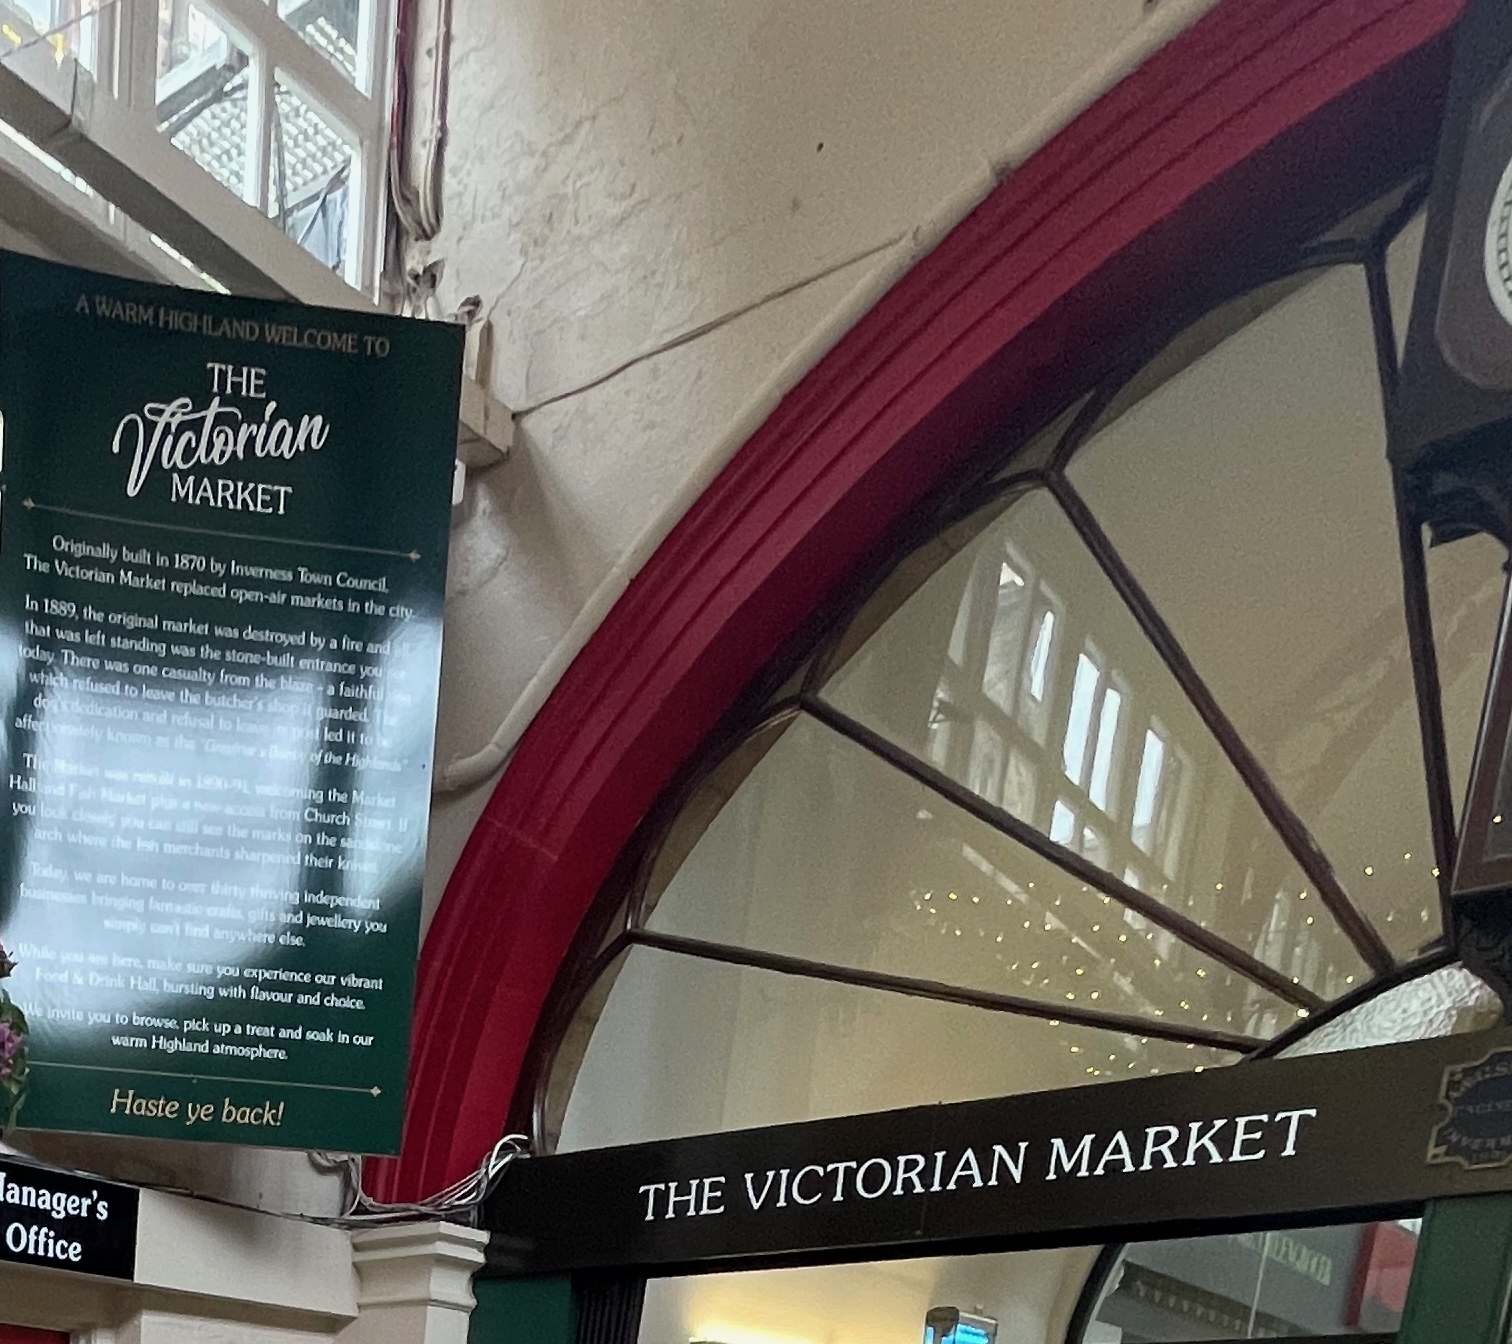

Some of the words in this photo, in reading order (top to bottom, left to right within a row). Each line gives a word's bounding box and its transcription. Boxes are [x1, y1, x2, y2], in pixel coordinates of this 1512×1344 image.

[75, 293, 89, 314] A
[94, 294, 154, 325] WARM
[158, 306, 259, 341] HIGHLAND
[264, 322, 357, 353] WELCOME
[362, 335, 389, 357] TO
[206, 362, 266, 398] THE
[112, 396, 330, 498] Victorian
[170, 472, 292, 515] MARKET
[52, 534, 117, 563] Originally
[122, 545, 151, 565] built
[156, 551, 169, 567] in
[174, 552, 205, 571] 1870
[210, 556, 226, 577] by
[230, 559, 293, 581] Inverness
[297, 566, 332, 586] Town
[23, 552, 50, 573] The
[54, 558, 114, 584] Victorian
[119, 568, 165, 591] Market
[170, 579, 226, 598] replaced
[230, 588, 286, 604] open-air
[290, 592, 343, 611] markets
[347, 598, 360, 612] in
[364, 599, 385, 615] the
[24, 593, 38, 611] In
[43, 597, 78, 620] 1889,
[82, 604, 104, 622] the
[108, 611, 158, 629] original
[162, 617, 208, 635] market
[214, 624, 239, 638] was
[242, 624, 305, 646] destroyed
[309, 630, 325, 651] by
[329, 638, 337, 649] a
[341, 633, 363, 652] fire
[366, 640, 391, 655] and
[24, 620, 50, 637] that
[55, 628, 81, 642] was
[84, 628, 105, 646] left
[110, 635, 166, 657] standing
[170, 644, 195, 657] was
[200, 643, 221, 660] the
[224, 649, 294, 668] stone-built
[298, 657, 355, 674] entrance
[359, 664, 382, 679] you
[29, 670, 68, 688] which
[72, 676, 120, 695] refused
[124, 684, 138, 697] to
[142, 683, 175, 701] leave
[179, 689, 200, 704] the
[204, 690, 263, 711] butcher's
[60, 648, 100, 669] There
[103, 659, 129, 673] was
[132, 663, 157, 676] one
[161, 666, 215, 685] casualty
[219, 668, 250, 686] from
[254, 672, 276, 689] the
[326, 684, 334, 695] a
[339, 680, 383, 701] faithful
[70, 698, 137, 720] dedication
[142, 709, 167, 723] and
[218, 716, 232, 731] to
[323, 725, 343, 742] led
[346, 730, 354, 743] it
[359, 732, 373, 745] to
[323, 751, 342, 765] the
[9, 773, 35, 792] Hall
[303, 806, 350, 825] Church
[328, 787, 347, 803] the
[12, 801, 36, 815] you
[294, 831, 311, 844] on
[316, 831, 337, 847] the
[304, 852, 333, 868] their
[96, 873, 116, 885] are
[120, 870, 157, 888] home
[161, 877, 175, 890] to
[304, 889, 379, 910] independent
[278, 909, 303, 923] and
[305, 912, 361, 932] jewellery
[364, 920, 387, 934] you
[278, 930, 305, 947] else.
[147, 955, 182, 971] make
[186, 962, 212, 975] sure
[216, 965, 239, 978] you
[243, 967, 311, 982] experience
[314, 974, 336, 985] our
[340, 972, 383, 990] vibrant
[163, 977, 214, 999] bursting
[218, 984, 246, 999] with
[250, 984, 293, 1003] flavour
[296, 991, 320, 1005] and
[323, 992, 365, 1010] choice.
[47, 1005, 83, 1021] invite
[87, 1011, 110, 1025] you
[115, 1012, 128, 1024] to
[183, 1016, 209, 1033] pick
[213, 1022, 231, 1036] up
[233, 1023, 241, 1034] a
[245, 1023, 274, 1037] treat
[278, 1024, 302, 1039] and
[305, 1027, 333, 1042] soak
[337, 1029, 349, 1043] in
[352, 1034, 374, 1045] our
[111, 1035, 147, 1048] warm
[151, 1034, 209, 1053] Highland
[212, 1043, 288, 1060] atmosphere.
[110, 1088, 179, 1118] Haste
[185, 1102, 213, 1125] ye
[221, 1096, 284, 1126] back!
[639, 1176, 726, 1222] THE
[744, 1140, 1028, 1211] VICTORIAN
[1044, 1108, 1318, 1182] MARKET
[5, 1222, 82, 1262] Office
